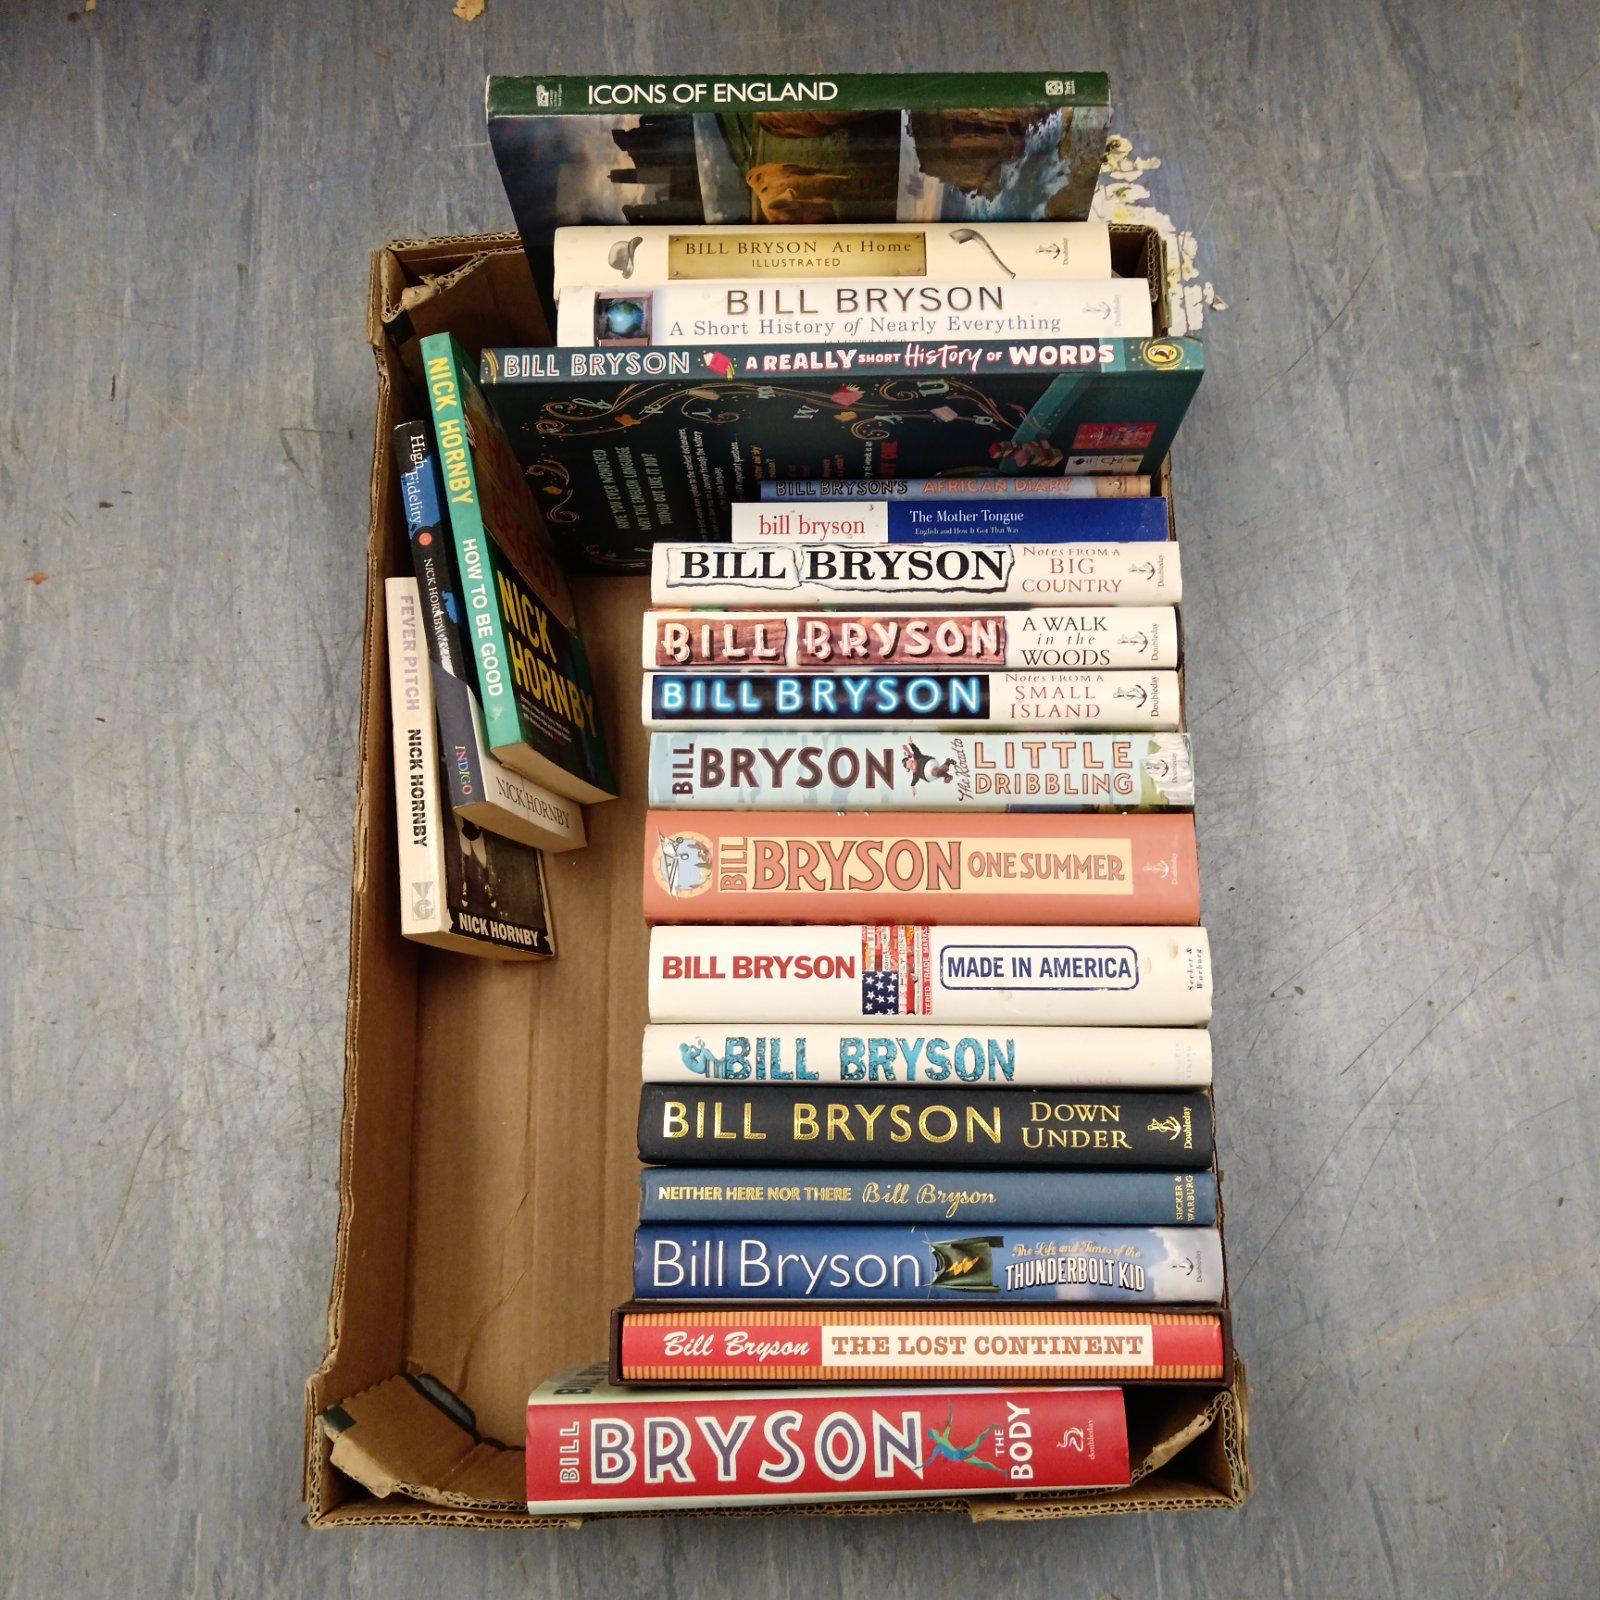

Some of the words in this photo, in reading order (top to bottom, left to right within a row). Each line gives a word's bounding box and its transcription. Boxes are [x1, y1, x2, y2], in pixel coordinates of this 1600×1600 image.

[588, 83, 667, 105] ICONS
[673, 82, 707, 104] OF
[713, 81, 838, 103] ENGLAND
[686, 242, 729, 255] BILL
[737, 241, 817, 254] BRYSON
[832, 240, 852, 253] At
[860, 240, 913, 253] Home
[751, 257, 841, 268] ILLUSTRATED
[727, 288, 819, 316] BILL
[837, 286, 1003, 314] BRYSON
[669, 321, 685, 336] A
[693, 319, 749, 336] Short
[759, 318, 836, 339] History
[844, 316, 864, 336] of
[871, 315, 937, 337] Nearly
[947, 314, 1061, 334] Everything
[503, 354, 560, 378] BILL
[570, 351, 690, 377] BRYSON
[745, 356, 758, 370] A
[763, 350, 858, 372] REALLY
[857, 353, 901, 363] SHORT
[904, 343, 987, 372] History
[986, 350, 1003, 362] OF
[1008, 344, 1116, 366] WORDS
[427, 356, 457, 412] NICK
[410, 434, 427, 469] High
[438, 418, 475, 505] HORNBY
[592, 449, 614, 484] WONDERED
[615, 446, 638, 478] LANGUAGE
[404, 469, 424, 524] Fidelity
[603, 484, 622, 500] EVER
[775, 481, 816, 496] BILL
[820, 479, 908, 496] BRYSON'S
[923, 478, 1007, 494] AFRICAN
[1013, 477, 1073, 493] DIARY
[759, 514, 791, 536] bill
[797, 514, 865, 541] bryson
[909, 510, 933, 523] The
[936, 509, 979, 522] Mother
[980, 509, 1025, 525] Tongue
[914, 527, 939, 536] English
[953, 527, 968, 535] How
[990, 526, 1005, 534] That
[1006, 526, 1019, 535] Way
[462, 537, 484, 580] HOW
[680, 551, 786, 580] BILL
[805, 550, 1007, 581] BRYSON
[1023, 545, 1064, 557] Notes
[1068, 547, 1109, 556] FROM
[1112, 547, 1121, 556] A
[1050, 558, 1095, 575] BIG
[423, 557, 436, 586] NICK
[1021, 578, 1122, 593] COUNTRY
[471, 583, 488, 611] TO
[400, 595, 417, 652] FEVER
[475, 613, 494, 639] BE
[496, 569, 558, 664] NICK
[1022, 616, 1037, 631] A
[1042, 616, 1109, 632] WALK
[661, 622, 777, 663] BILL
[802, 619, 999, 660] BRYSON
[1037, 632, 1054, 645] in
[1067, 631, 1096, 645] the
[1151, 622, 1159, 661] Doubleday
[480, 643, 504, 697] GOOD
[1021, 649, 1111, 666] WOODS
[403, 657, 421, 711] PITCH
[508, 632, 597, 738] HORNBY
[1005, 673, 1047, 683] Notes
[1051, 674, 1091, 683] FROM
[1095, 674, 1104, 683] A
[1015, 685, 1096, 700] SMALL
[662, 681, 761, 711] BILL
[777, 678, 979, 713] BRYSON
[1010, 703, 1101, 719] ISLAND
[1150, 675, 1159, 717] Doubleday
[407, 729, 424, 771] NICK
[951, 738, 964, 748] to
[974, 741, 1134, 770] LITTLE
[455, 745, 473, 795] INDIGO
[672, 743, 694, 795] BILL
[700, 746, 895, 790] BRYSON
[952, 747, 970, 778] Road
[957, 779, 974, 802] The
[974, 772, 1134, 795] DRIBBLING
[410, 775, 428, 848] HORNBY
[496, 776, 527, 808] NICK
[526, 790, 570, 829] HORNBY
[720, 837, 748, 892] BILL
[752, 839, 962, 892] BRYSON
[967, 851, 1017, 878] ONE
[1020, 853, 1126, 881] SUMMER
[459, 911, 489, 936] NICK
[490, 920, 539, 947] HORNBY
[662, 955, 726, 980] BILL
[732, 955, 856, 980] BRYSON
[947, 956, 1004, 978] MADE
[1011, 957, 1032, 978] IN
[1039, 957, 1132, 979] AMERICA
[725, 1036, 820, 1082] BILL
[840, 1036, 1015, 1082] BRYSON
[663, 1101, 767, 1140] BILL
[793, 1103, 1002, 1144] BRYSON
[1029, 1101, 1121, 1123] DOWN
[1022, 1127, 1133, 1149] UNDER
[1184, 1106, 1193, 1150] Doubleday
[658, 1186, 722, 1201] NEITHER
[726, 1186, 764, 1201] HERE
[767, 1186, 800, 1201] NOR
[804, 1186, 852, 1202] THERE
[862, 1182, 910, 1204] Bill
[917, 1182, 997, 1219] Bryson
[1186, 1174, 1194, 1221] WARBURG
[1012, 1243, 1032, 1258] The
[1034, 1241, 1057, 1257] Life
[1058, 1242, 1079, 1254] and
[1078, 1240, 1112, 1255] Times
[1113, 1243, 1126, 1258] of
[1125, 1244, 1143, 1258] the
[653, 1239, 724, 1287] Bill
[740, 1239, 920, 1295] Bryson
[1004, 1257, 1115, 1291] THUNDERBOLT
[1118, 1260, 1145, 1292] KID
[663, 1331, 714, 1357] Bill
[723, 1331, 810, 1362] Bryson
[831, 1336, 891, 1355] THE
[897, 1336, 968, 1355] LOST
[973, 1335, 1144, 1355] CONTINENT
[559, 1420, 580, 1483] BILL
[590, 1408, 924, 1485] BRYSON
[995, 1427, 1006, 1458] THE
[1006, 1400, 1035, 1480] BODY
[1087, 1418, 1096, 1461] doubleday
